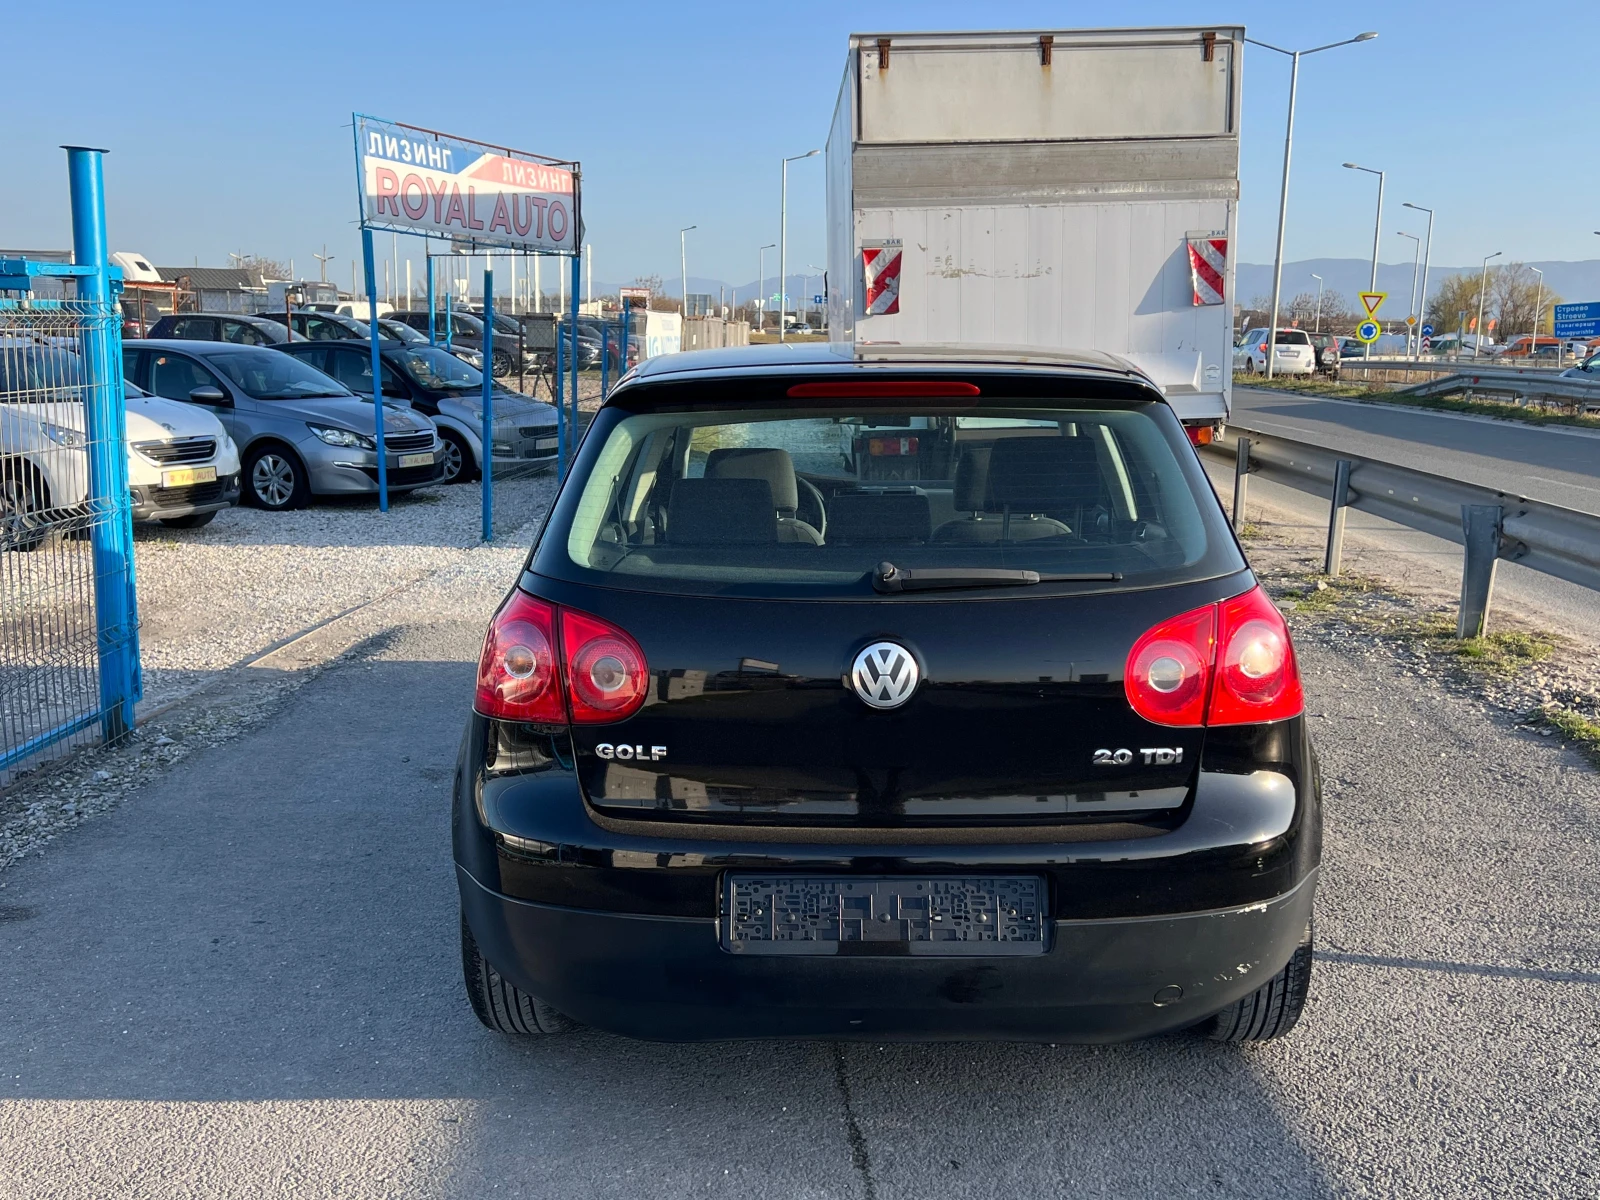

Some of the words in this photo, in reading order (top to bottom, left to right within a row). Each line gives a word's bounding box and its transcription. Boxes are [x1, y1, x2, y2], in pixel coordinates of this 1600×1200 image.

[369, 132, 451, 170] ЛИЗИНГ
[502, 161, 569, 193] ЛИЗИНГ
[375, 166, 484, 231] ROYAL
[489, 190, 568, 242] AUTO
[1556, 305, 1589, 314] Строево
[1556, 312, 1587, 320] Stroevo
[170, 471, 195, 483] RYAL
[197, 469, 216, 480] AUTO
[595, 743, 668, 761] GOLF
[1139, 747, 1184, 765] TDI
